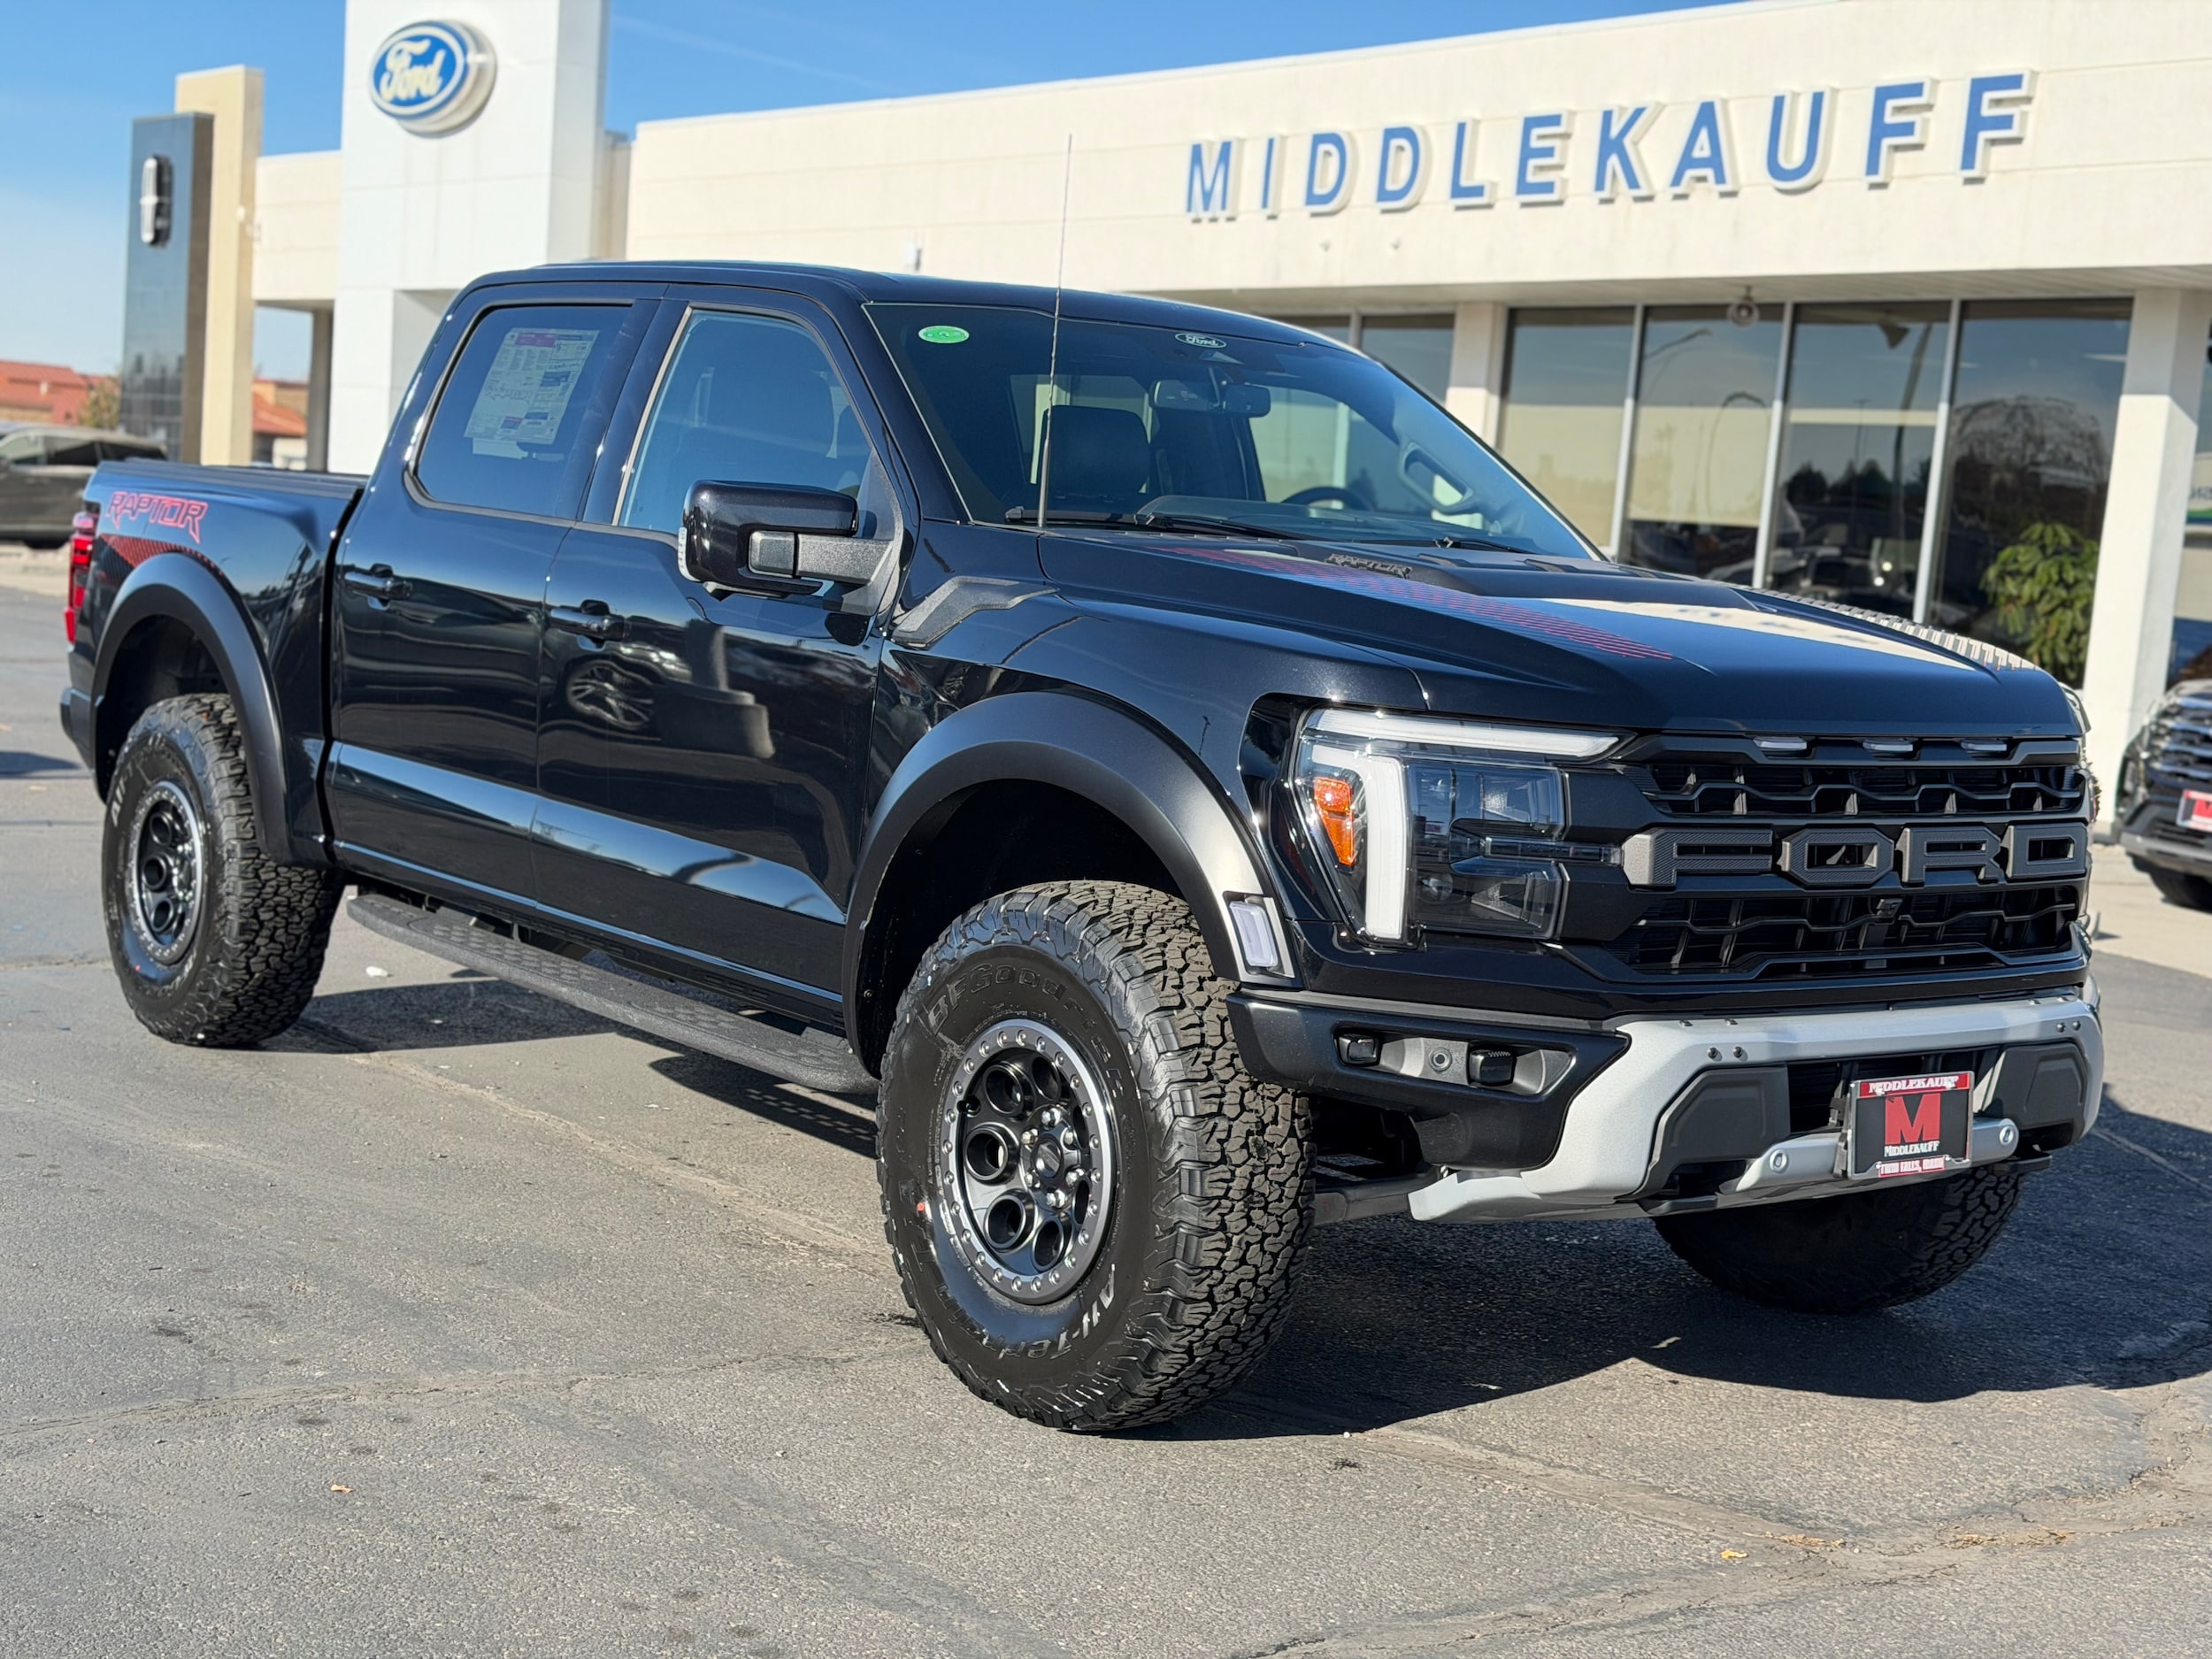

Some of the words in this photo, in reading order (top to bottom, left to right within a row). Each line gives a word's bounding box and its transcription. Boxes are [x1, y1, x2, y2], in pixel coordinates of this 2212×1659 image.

[380, 38, 447, 103] Ford
[1184, 71, 2035, 220] MIDDLEKAUFF
[105, 491, 209, 544] RAPTOR
[1325, 553, 1413, 580] RAPTOR
[1622, 823, 2087, 884] FORD
[1885, 1093, 1941, 1145] M
[1884, 1141, 1940, 1157] MIDDLEKAUFF
